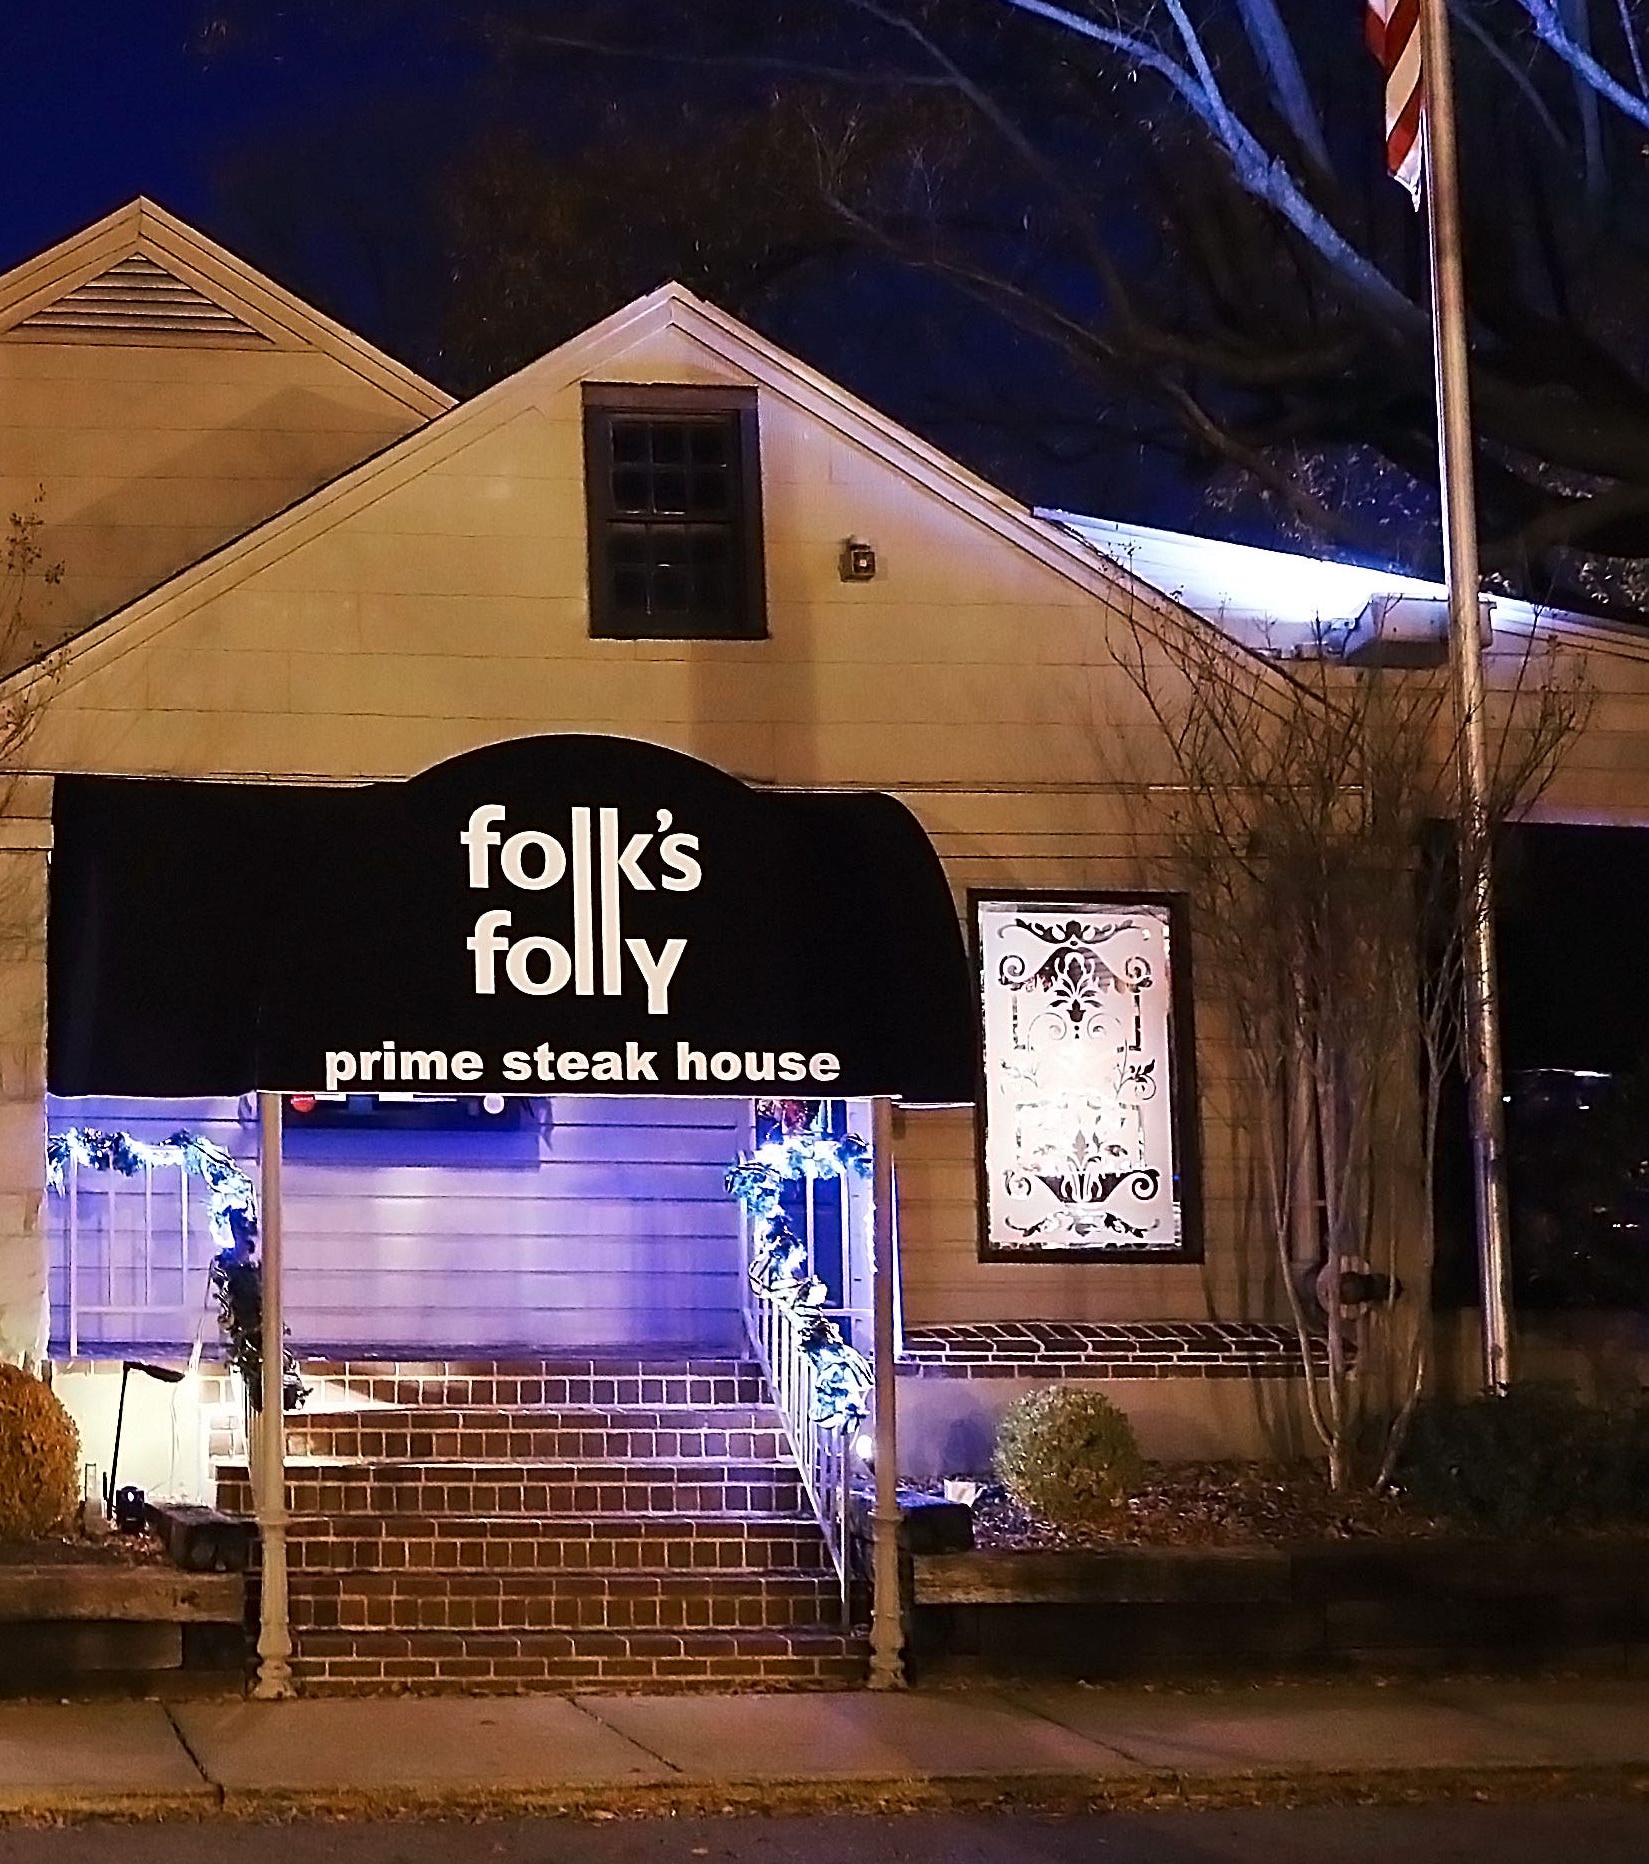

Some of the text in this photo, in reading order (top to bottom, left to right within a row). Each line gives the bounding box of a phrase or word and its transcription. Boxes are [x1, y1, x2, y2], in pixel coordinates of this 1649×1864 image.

[460, 803, 703, 892] folk's
[466, 909, 688, 1015] folly
[325, 1040, 841, 1091] prime steak house
